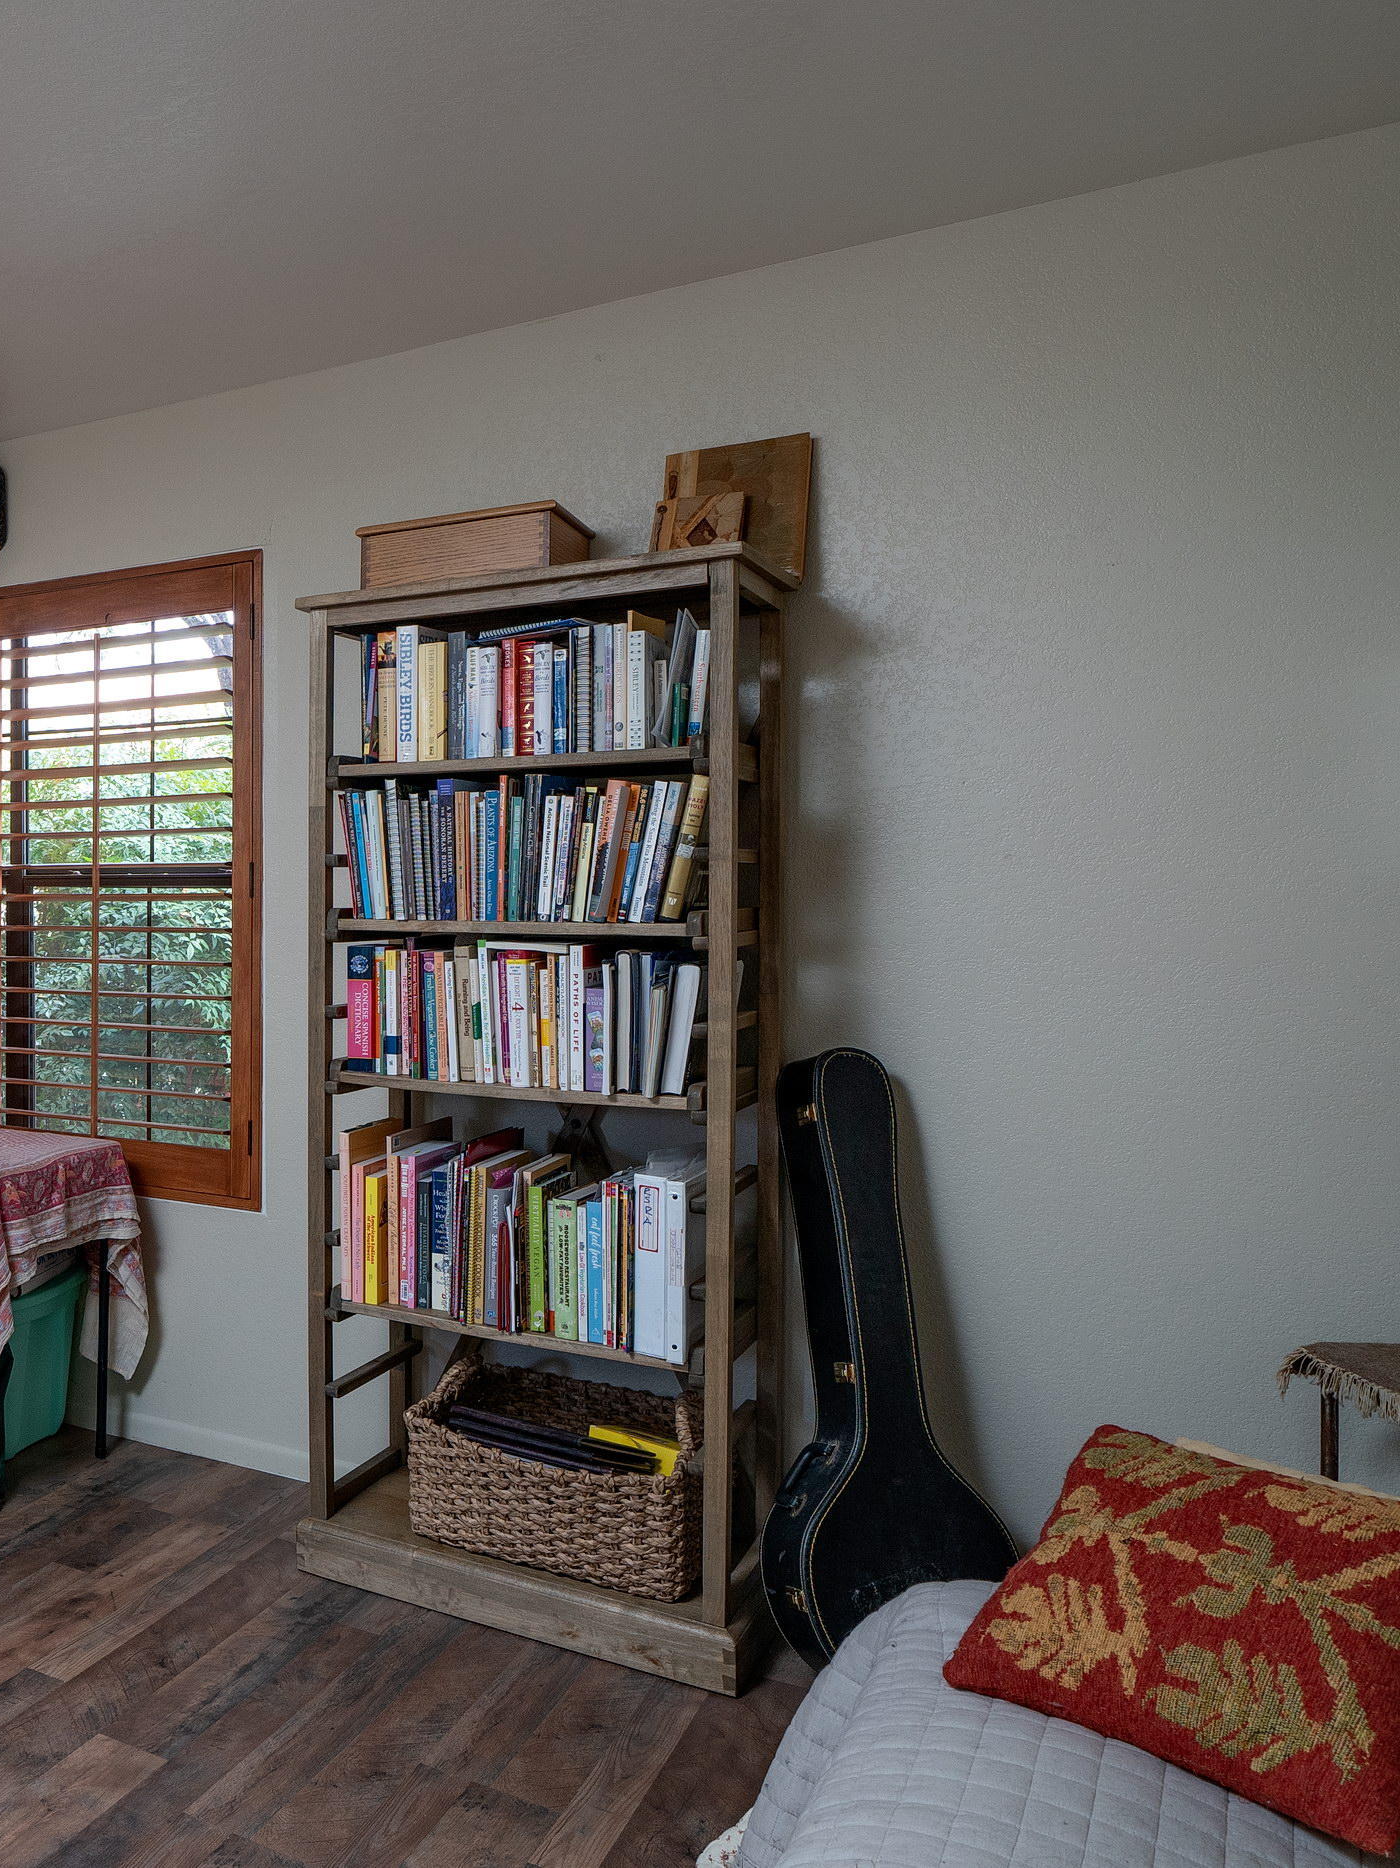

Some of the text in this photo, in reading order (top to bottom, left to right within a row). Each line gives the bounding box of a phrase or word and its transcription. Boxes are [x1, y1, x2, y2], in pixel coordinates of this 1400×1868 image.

[469, 649, 477, 682] KAUFMAN
[399, 632, 412, 743] SIBLEY BIRDS
[632, 666, 640, 692] SIBLEY
[693, 662, 706, 712] Southwestern
[605, 795, 613, 814] DELIA
[639, 789, 648, 804] 98.6
[526, 806, 536, 831] Canyon
[602, 817, 611, 841] OWENS
[624, 810, 636, 831] HIKING
[487, 797, 498, 872] PLANTS OF ARIZONA
[581, 825, 590, 860] Hiking Arizona
[621, 832, 633, 851] GUIDE
[639, 788, 663, 886] Exploring the Santa Rita Mountains
[526, 840, 534, 859] Chelly
[426, 974, 434, 990] Fresh
[587, 972, 603, 984] PAT
[462, 978, 470, 1004] Running
[426, 1000, 434, 1031] Vegetarian
[512, 1001, 525, 1012] 4
[572, 1012, 579, 1025] OF
[463, 1018, 471, 1036] Being
[429, 1047, 437, 1070] Cooker
[474, 1222, 482, 1263] MOOSEWOOD
[588, 1217, 602, 1269] eat feel fresh
